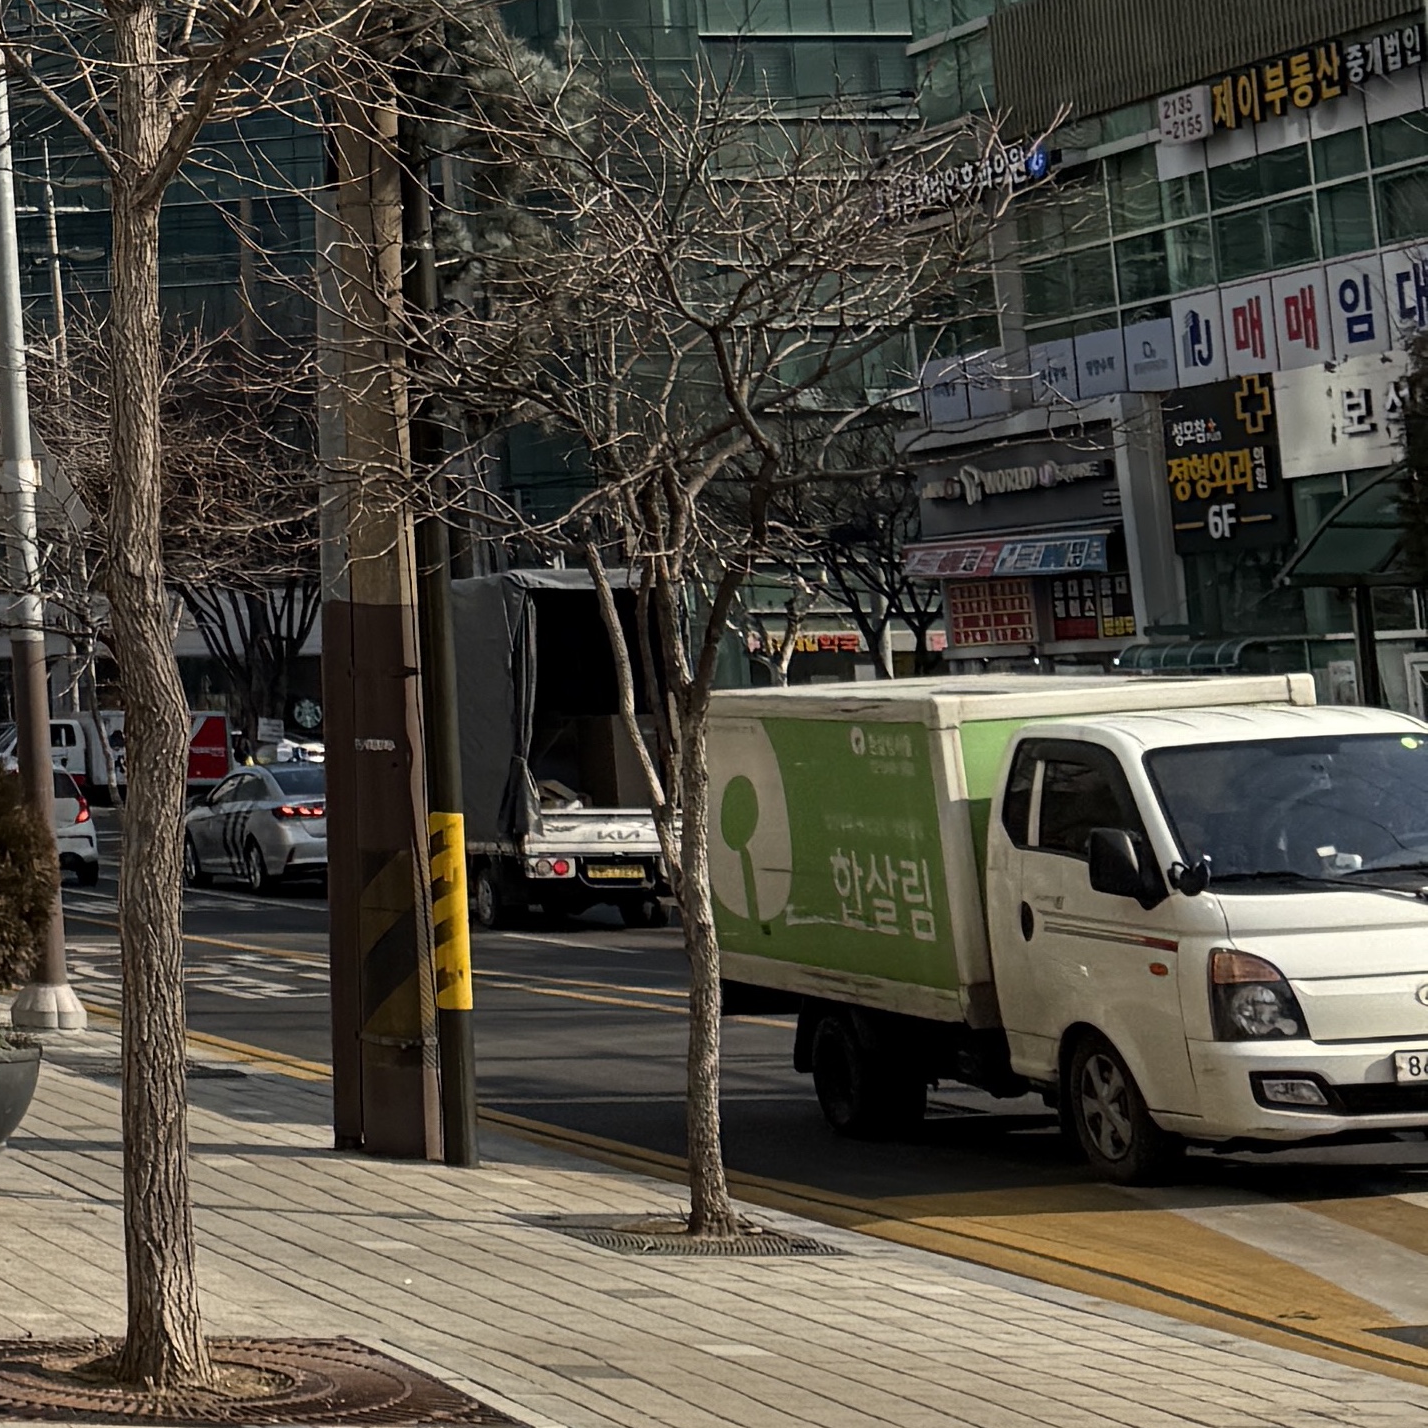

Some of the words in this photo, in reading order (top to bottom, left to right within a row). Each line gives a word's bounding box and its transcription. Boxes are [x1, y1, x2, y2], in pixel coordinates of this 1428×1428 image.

[1212, 42, 1343, 129] 제이부동산
[1346, 25, 1422, 84] 중개법인
[1168, 447, 1255, 501] 정형외과
[1207, 502, 1237, 539] 6F
[829, 847, 937, 942] 한살림
